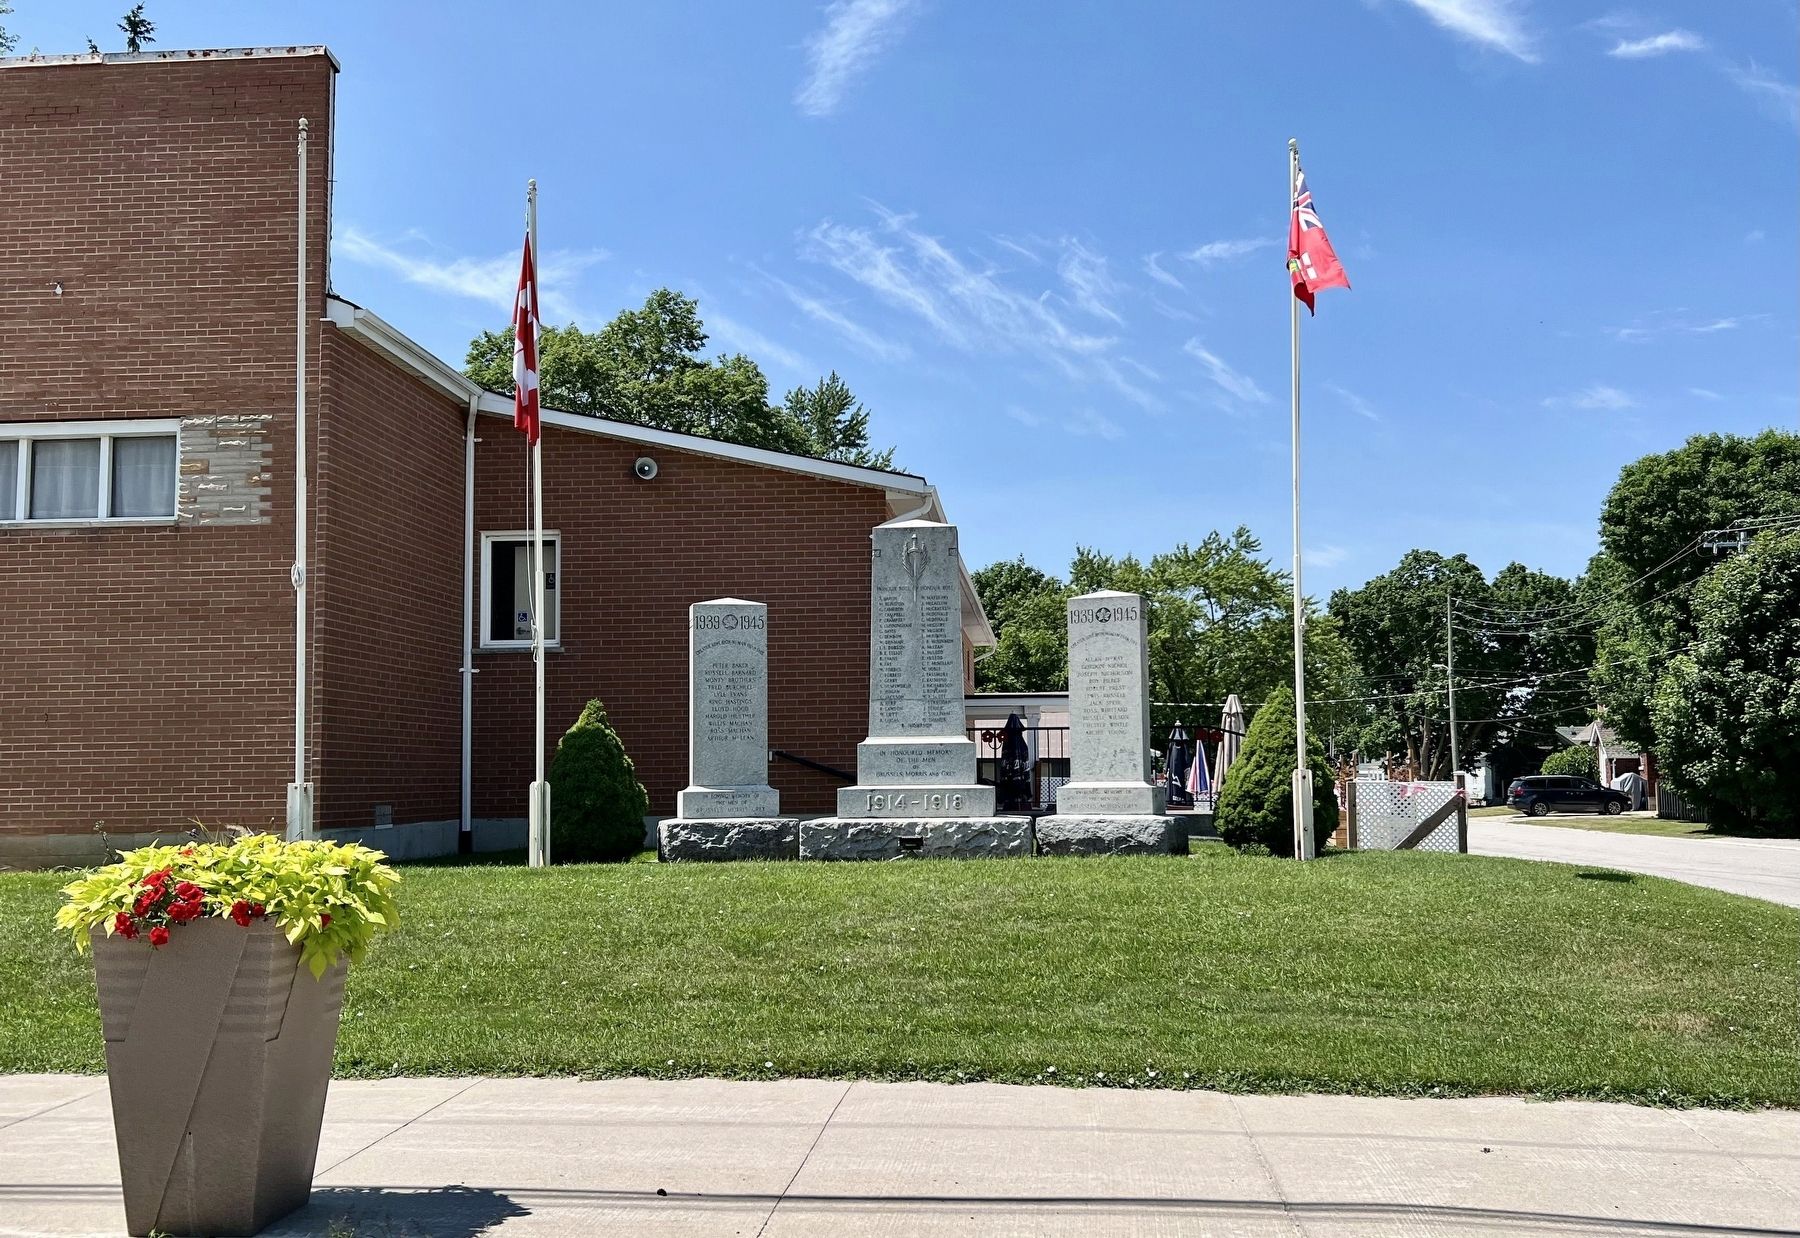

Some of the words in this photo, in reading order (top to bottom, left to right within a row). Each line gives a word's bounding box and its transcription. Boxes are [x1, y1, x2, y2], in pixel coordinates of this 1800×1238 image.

[695, 615, 719, 629] 1939
[740, 615, 764, 629] 1945
[1070, 609, 1094, 624] 1939
[1113, 607, 1137, 622] 1945
